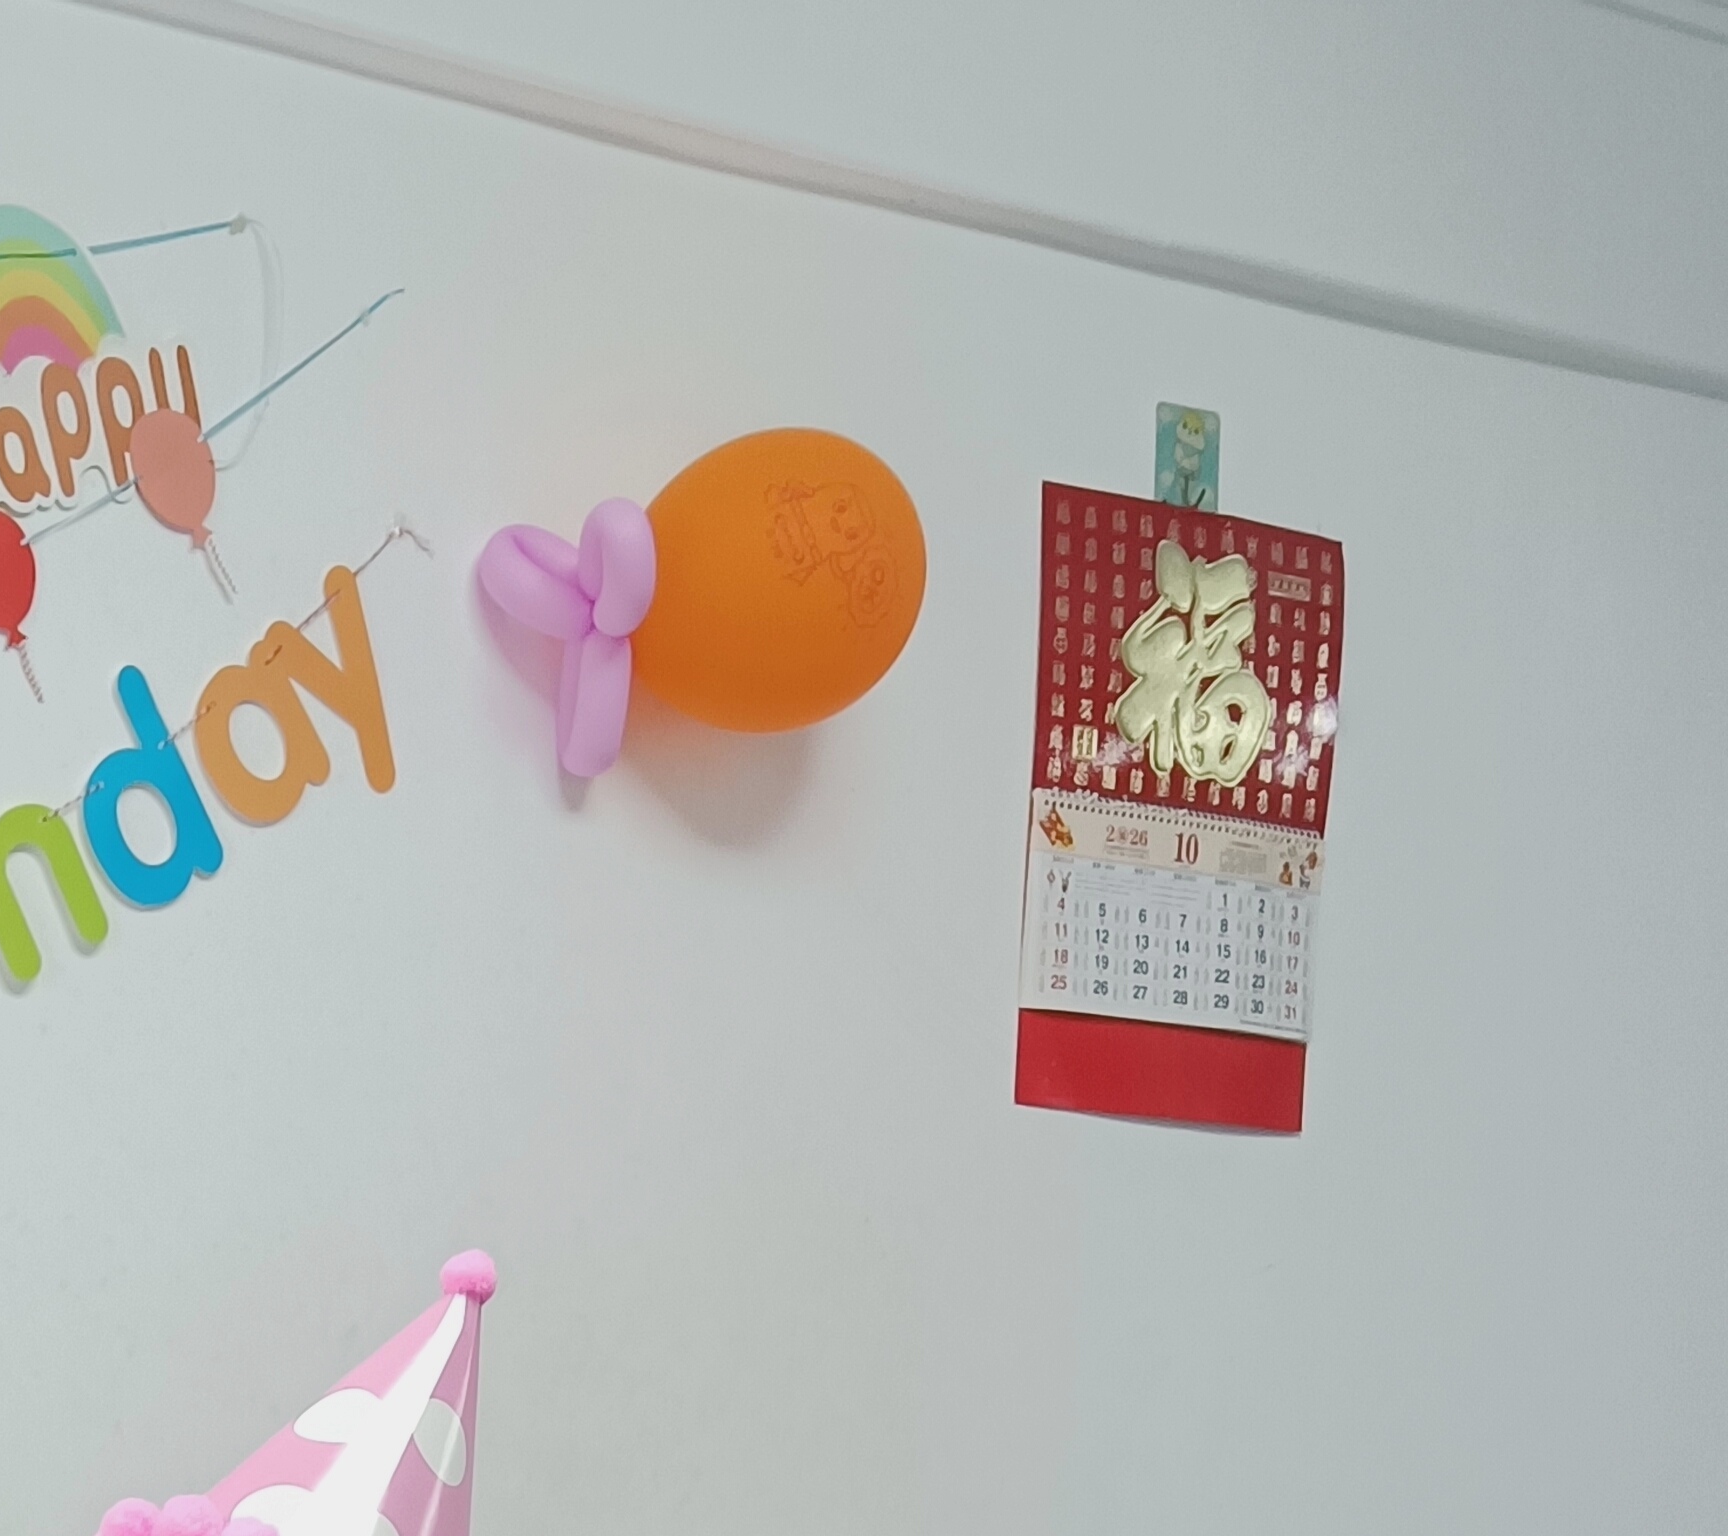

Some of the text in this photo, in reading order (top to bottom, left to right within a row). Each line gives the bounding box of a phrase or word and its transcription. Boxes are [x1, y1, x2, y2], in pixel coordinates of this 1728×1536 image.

[1115, 539, 1271, 787] 福
[1174, 833, 1199, 865] 10
[1057, 897, 1300, 945] 4 5 6 7 8 9 10
[1222, 894, 1299, 920] 1 2 3
[1055, 923, 1298, 970] 11 12 13 14 15 16 17
[1053, 949, 1298, 995] 18 19 20 21 22 23 24
[1050, 975, 1297, 1020] 25 26 27 28 29 30 31
